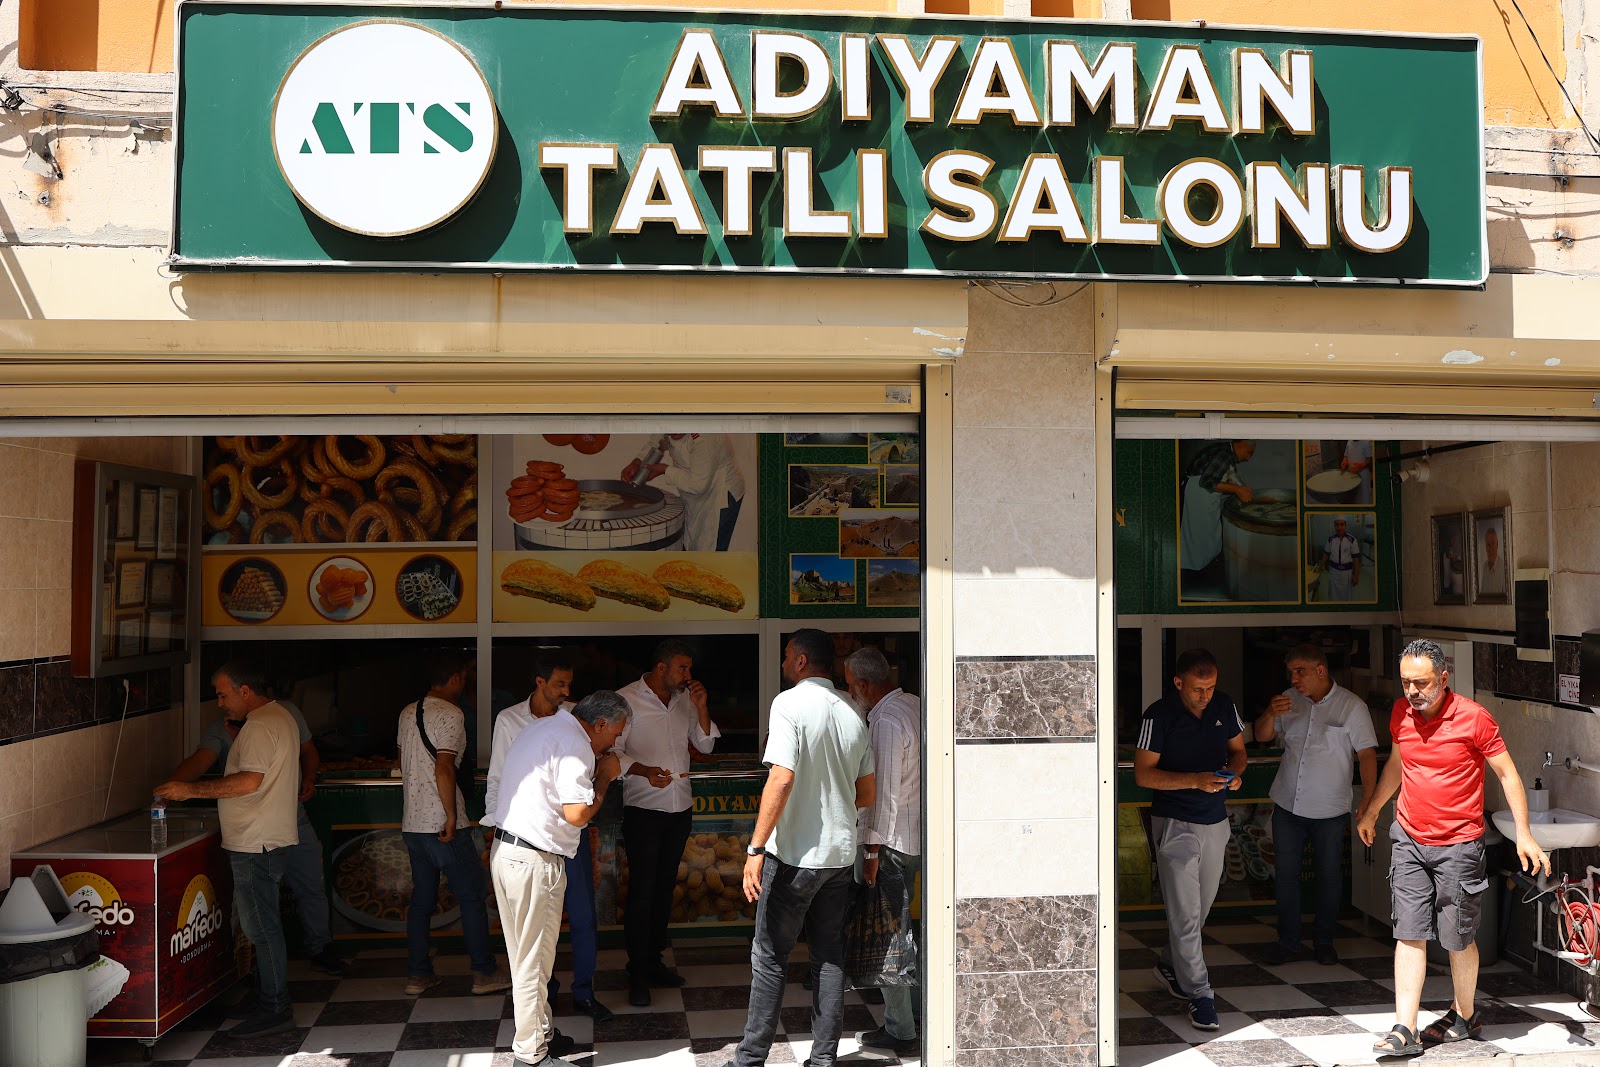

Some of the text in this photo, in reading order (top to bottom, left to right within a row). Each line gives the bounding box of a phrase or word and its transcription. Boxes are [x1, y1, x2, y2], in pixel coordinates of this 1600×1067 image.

[649, 28, 1316, 136] ADIYAMAN
[299, 102, 473, 154] ATS
[538, 142, 1414, 253] TATLI SALONU
[170, 903, 223, 957] marfedo
